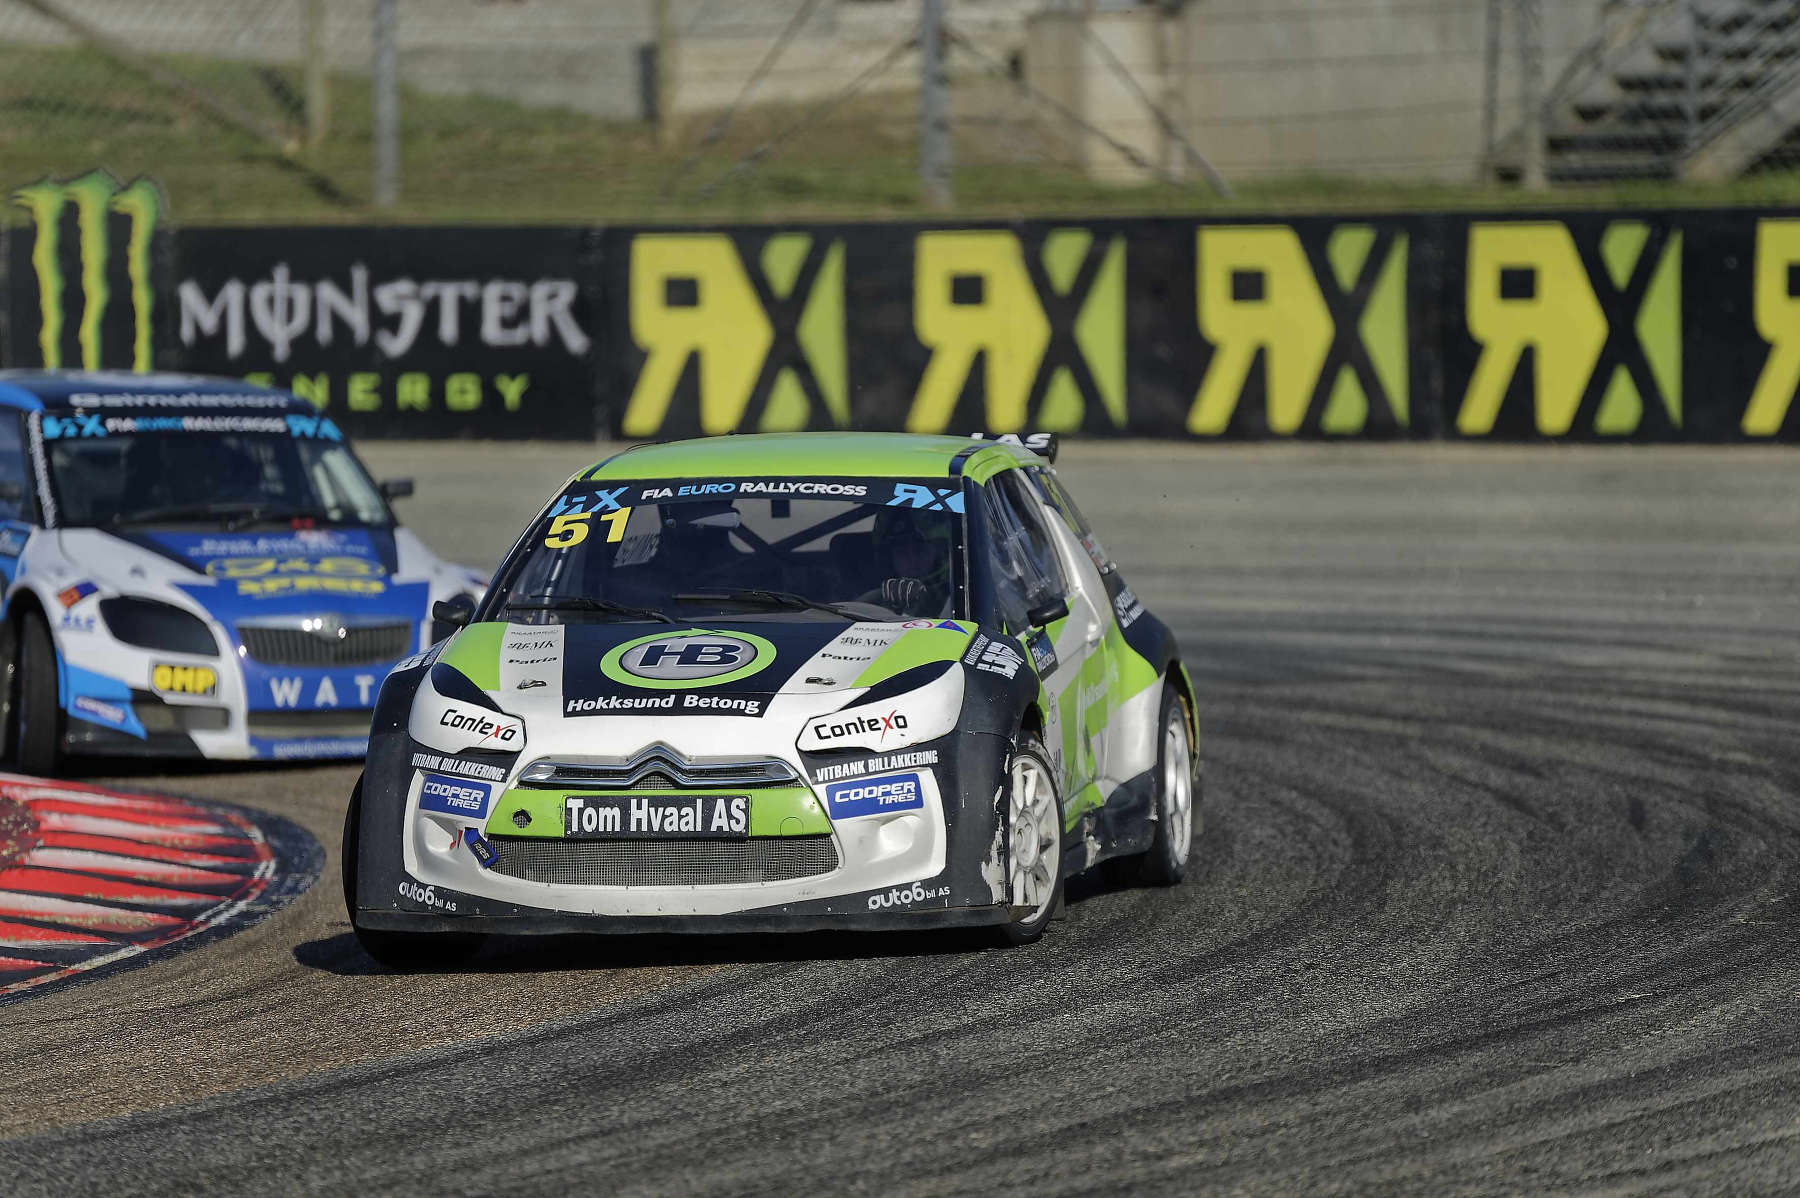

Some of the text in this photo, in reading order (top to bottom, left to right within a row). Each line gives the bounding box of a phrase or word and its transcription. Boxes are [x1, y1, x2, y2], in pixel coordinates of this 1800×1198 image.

[178, 262, 591, 363] MONSTER
[641, 487, 674, 500] FIA
[677, 482, 736, 497] EURO
[739, 482, 868, 496] RALLYCROSS
[544, 506, 633, 549] 51
[637, 643, 744, 669] HB
[153, 664, 216, 695] OMP
[566, 694, 761, 715] Hokksund Betong
[411, 752, 506, 782] VITBANK BILLAKKERING
[816, 750, 938, 782] VITBANK BILLAKKERING
[424, 782, 484, 802] COOPER
[447, 797, 481, 810] TIRES
[834, 781, 916, 803] COOPER
[877, 792, 916, 806] TIRES
[566, 798, 746, 832] Tom Hvaal AS
